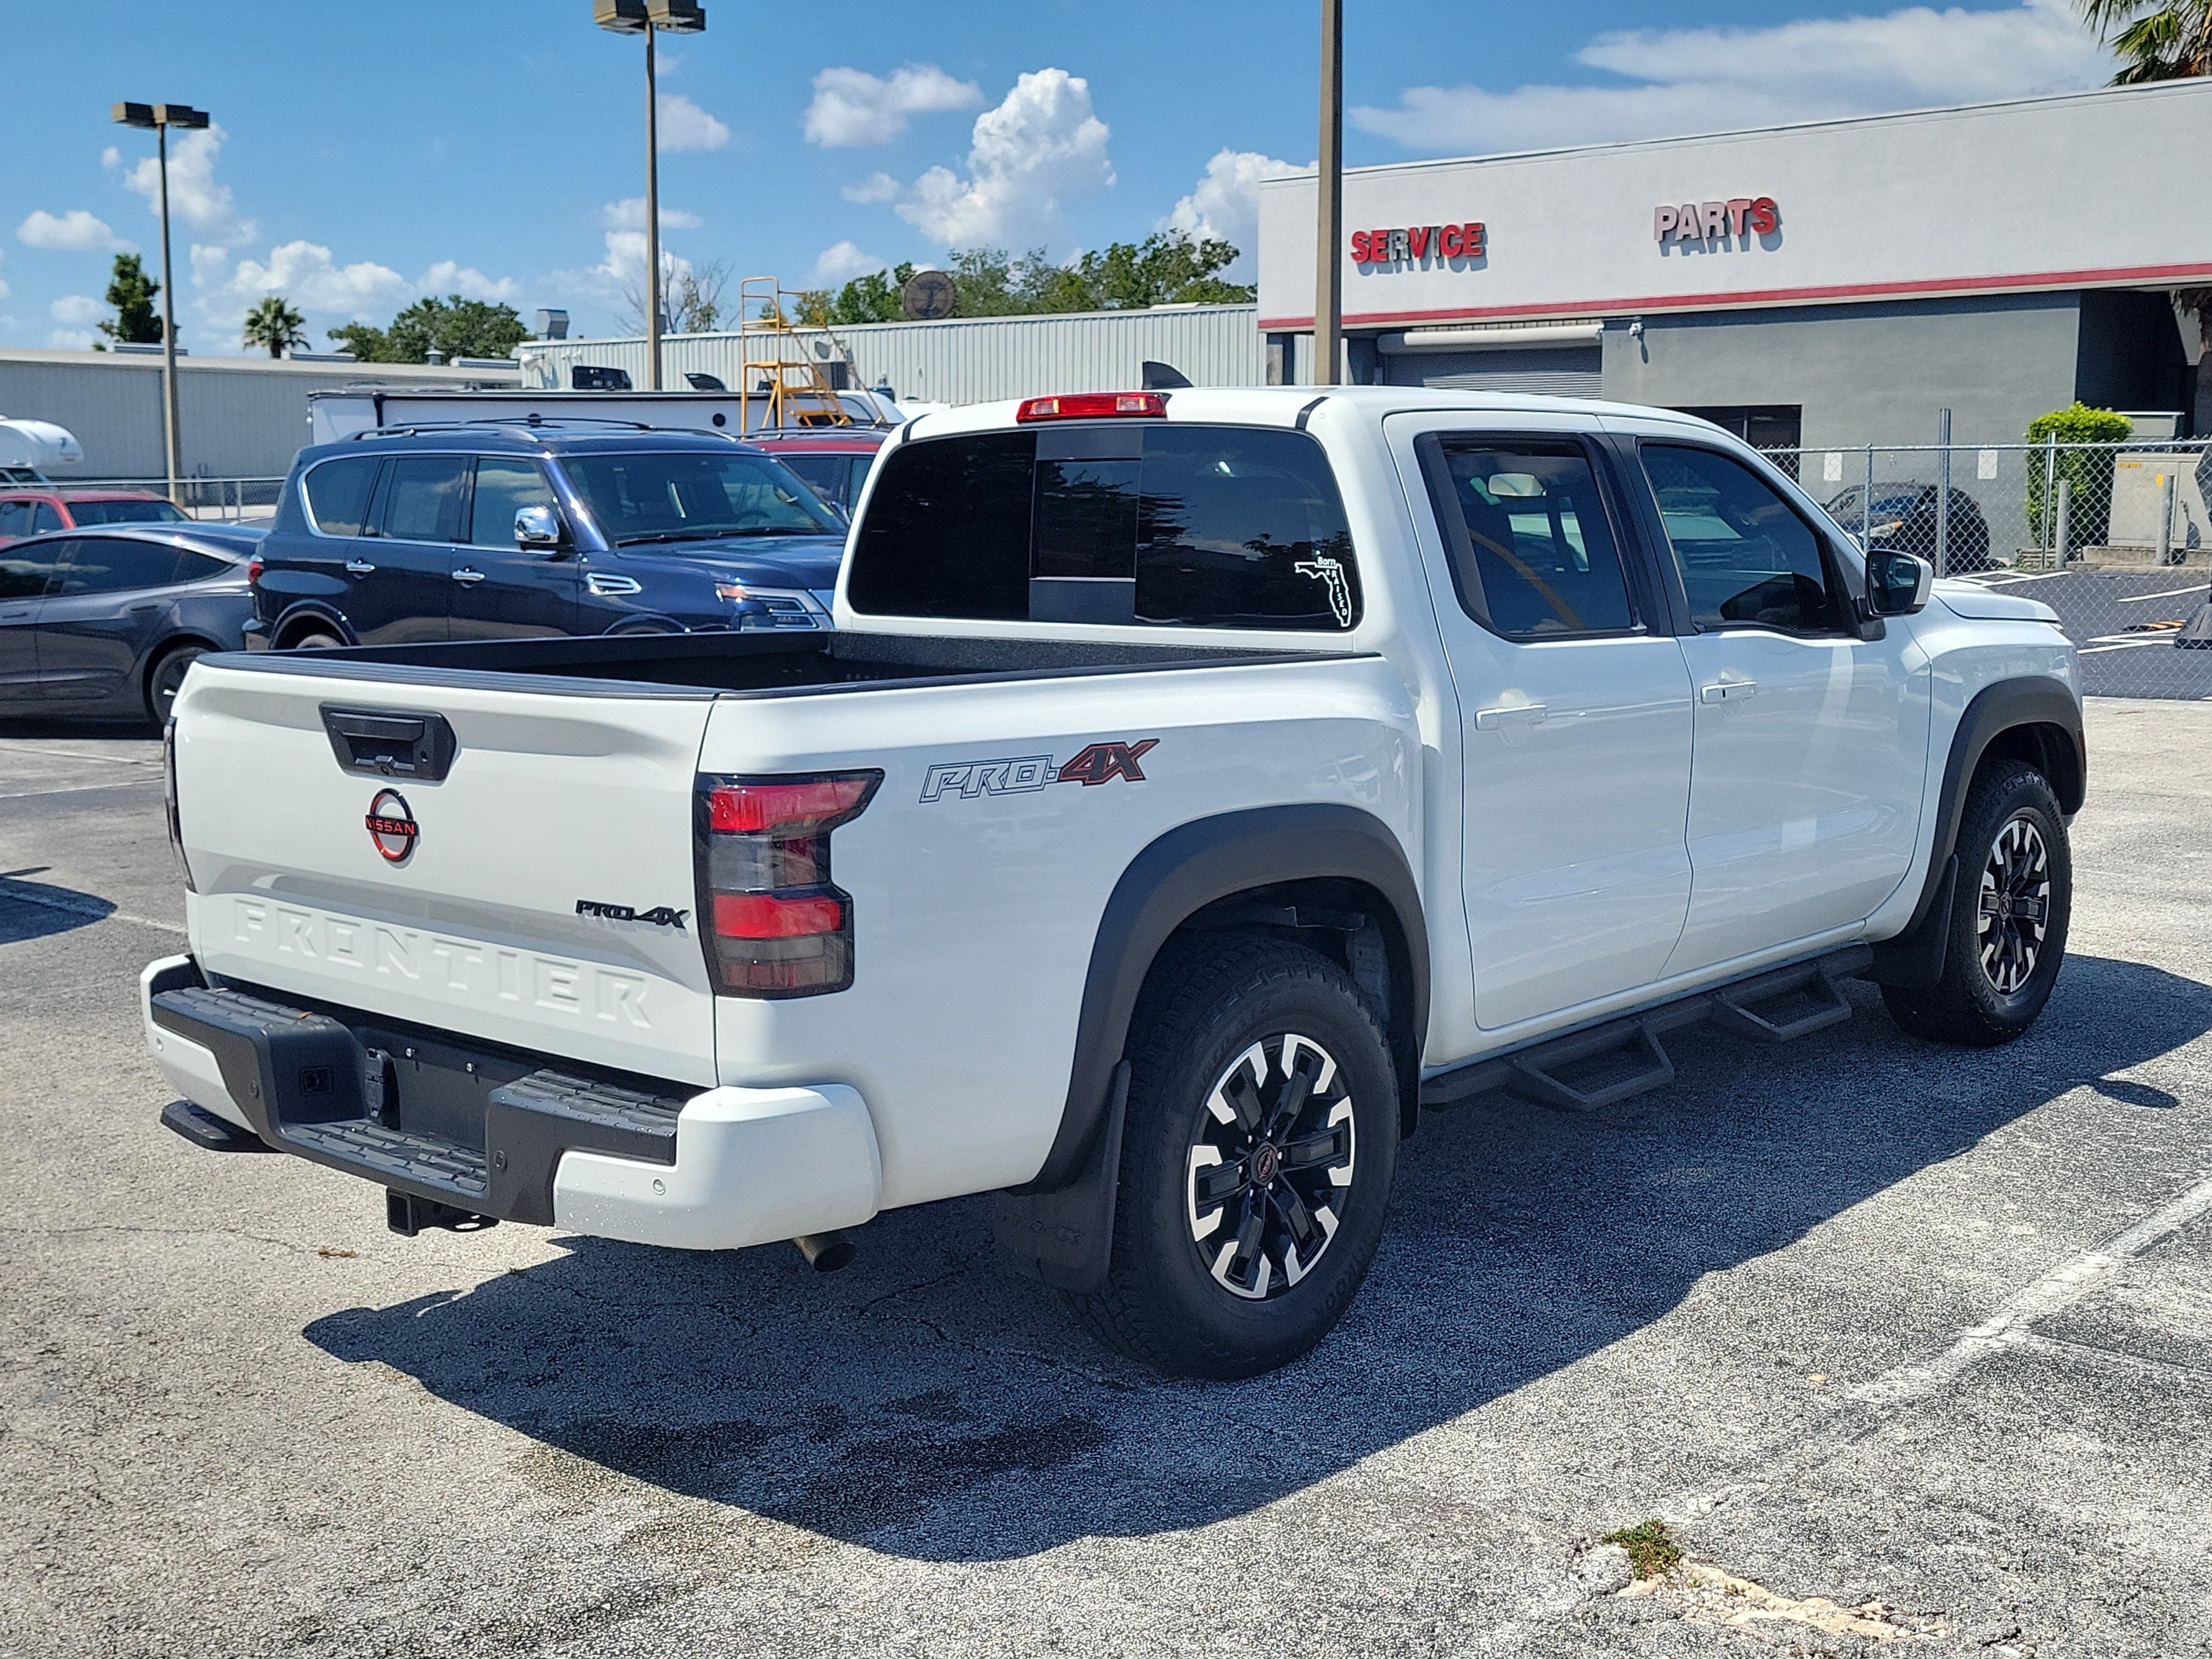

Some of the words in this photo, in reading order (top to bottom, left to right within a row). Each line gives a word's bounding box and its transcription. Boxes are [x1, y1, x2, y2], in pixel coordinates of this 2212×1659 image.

[1654, 198, 1778, 242] PARTS
[1351, 223, 1485, 263] SERVICE
[1318, 556, 1336, 566] Born
[1332, 571, 1347, 616] RAISED
[919, 738, 1160, 804] PRO-4X
[366, 816, 415, 835] NISSAN
[234, 898, 652, 1029] FRONTIER
